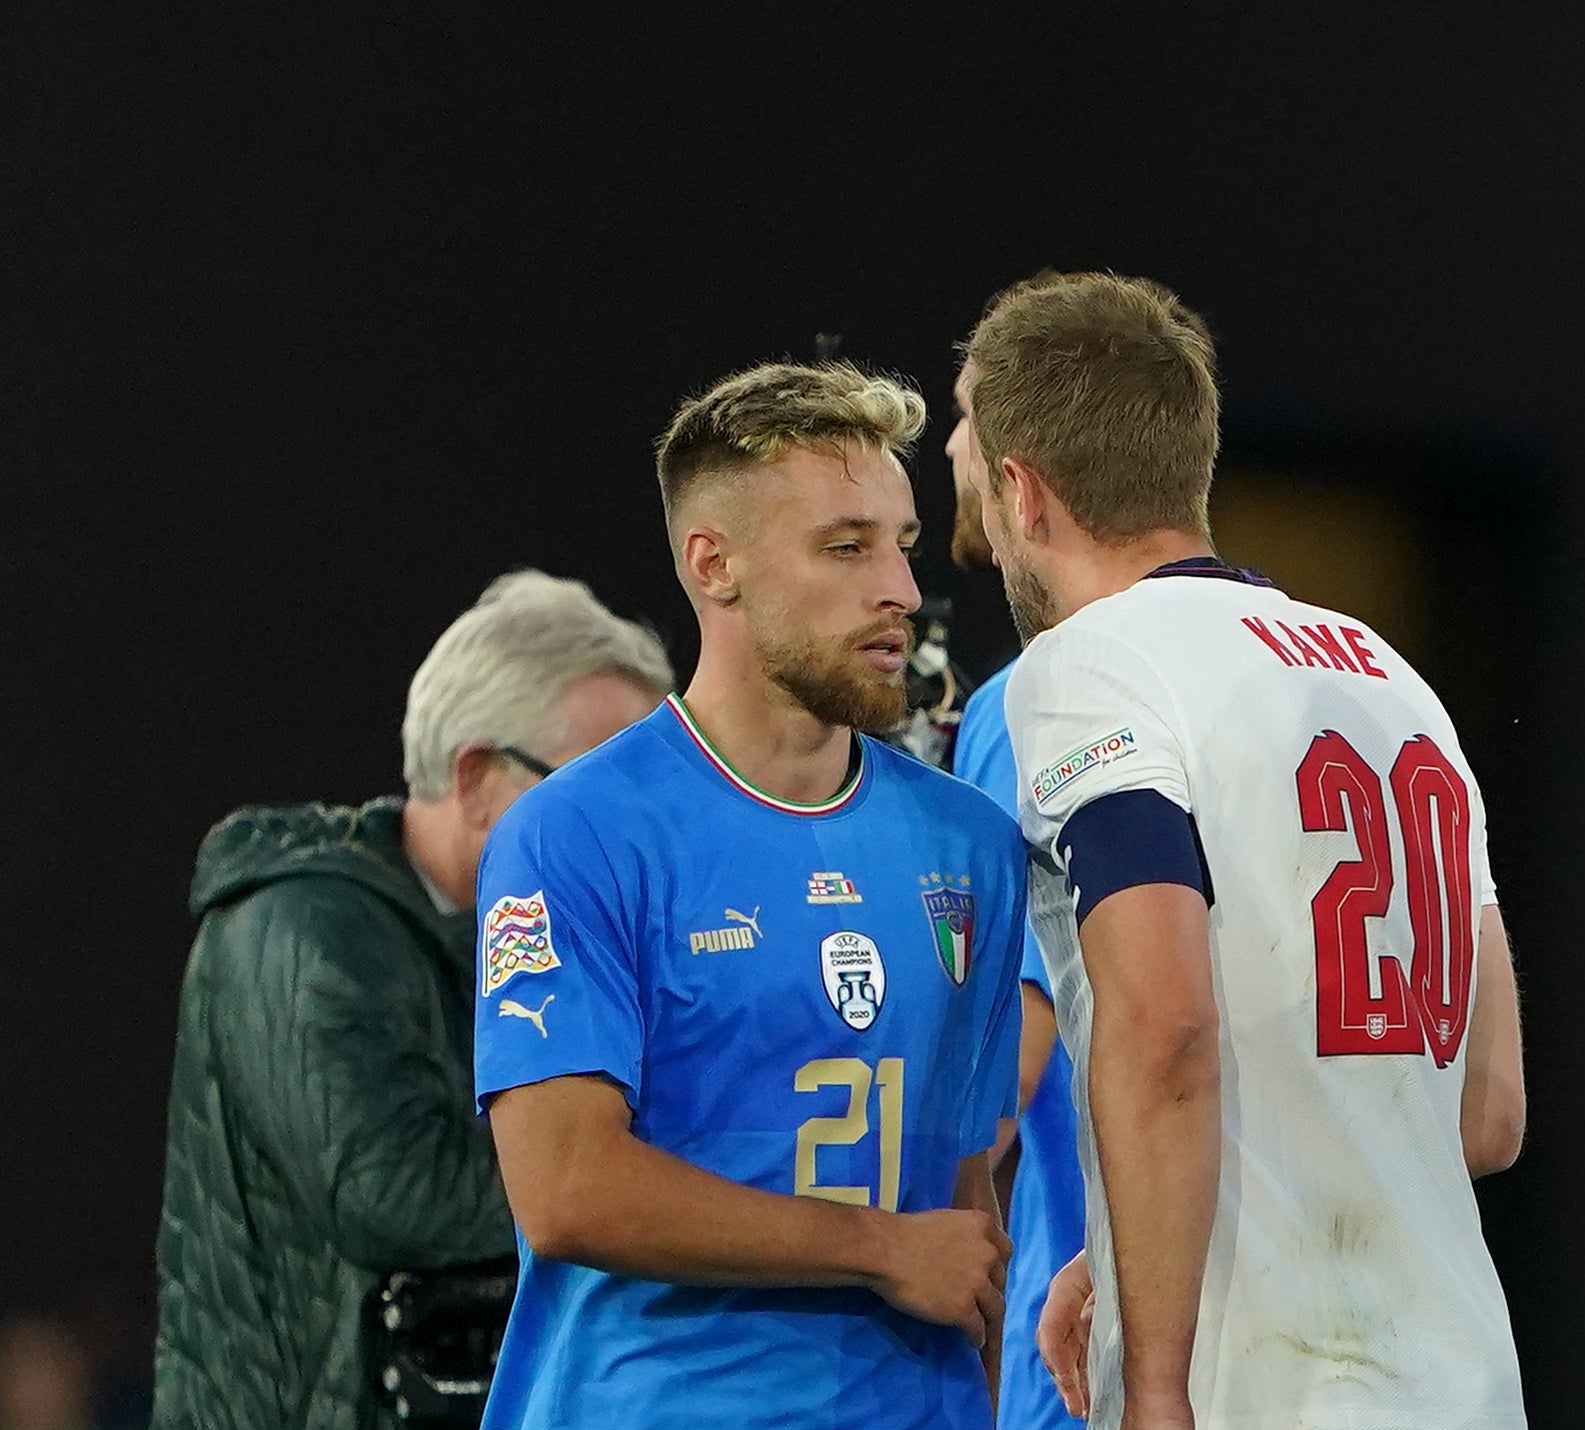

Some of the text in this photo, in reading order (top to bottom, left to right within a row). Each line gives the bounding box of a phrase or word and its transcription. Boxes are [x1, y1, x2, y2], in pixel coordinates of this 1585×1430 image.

[1241, 617, 1389, 680] KANE
[1034, 732, 1135, 800] FOUNDATION
[1296, 729, 1473, 1069] 20
[689, 927, 755, 955] PUMA
[830, 950, 871, 959] EUROPEAN
[831, 958, 873, 967] CHAMPIONS
[849, 1010, 870, 1019] 2020
[793, 1058, 904, 1211] 21
